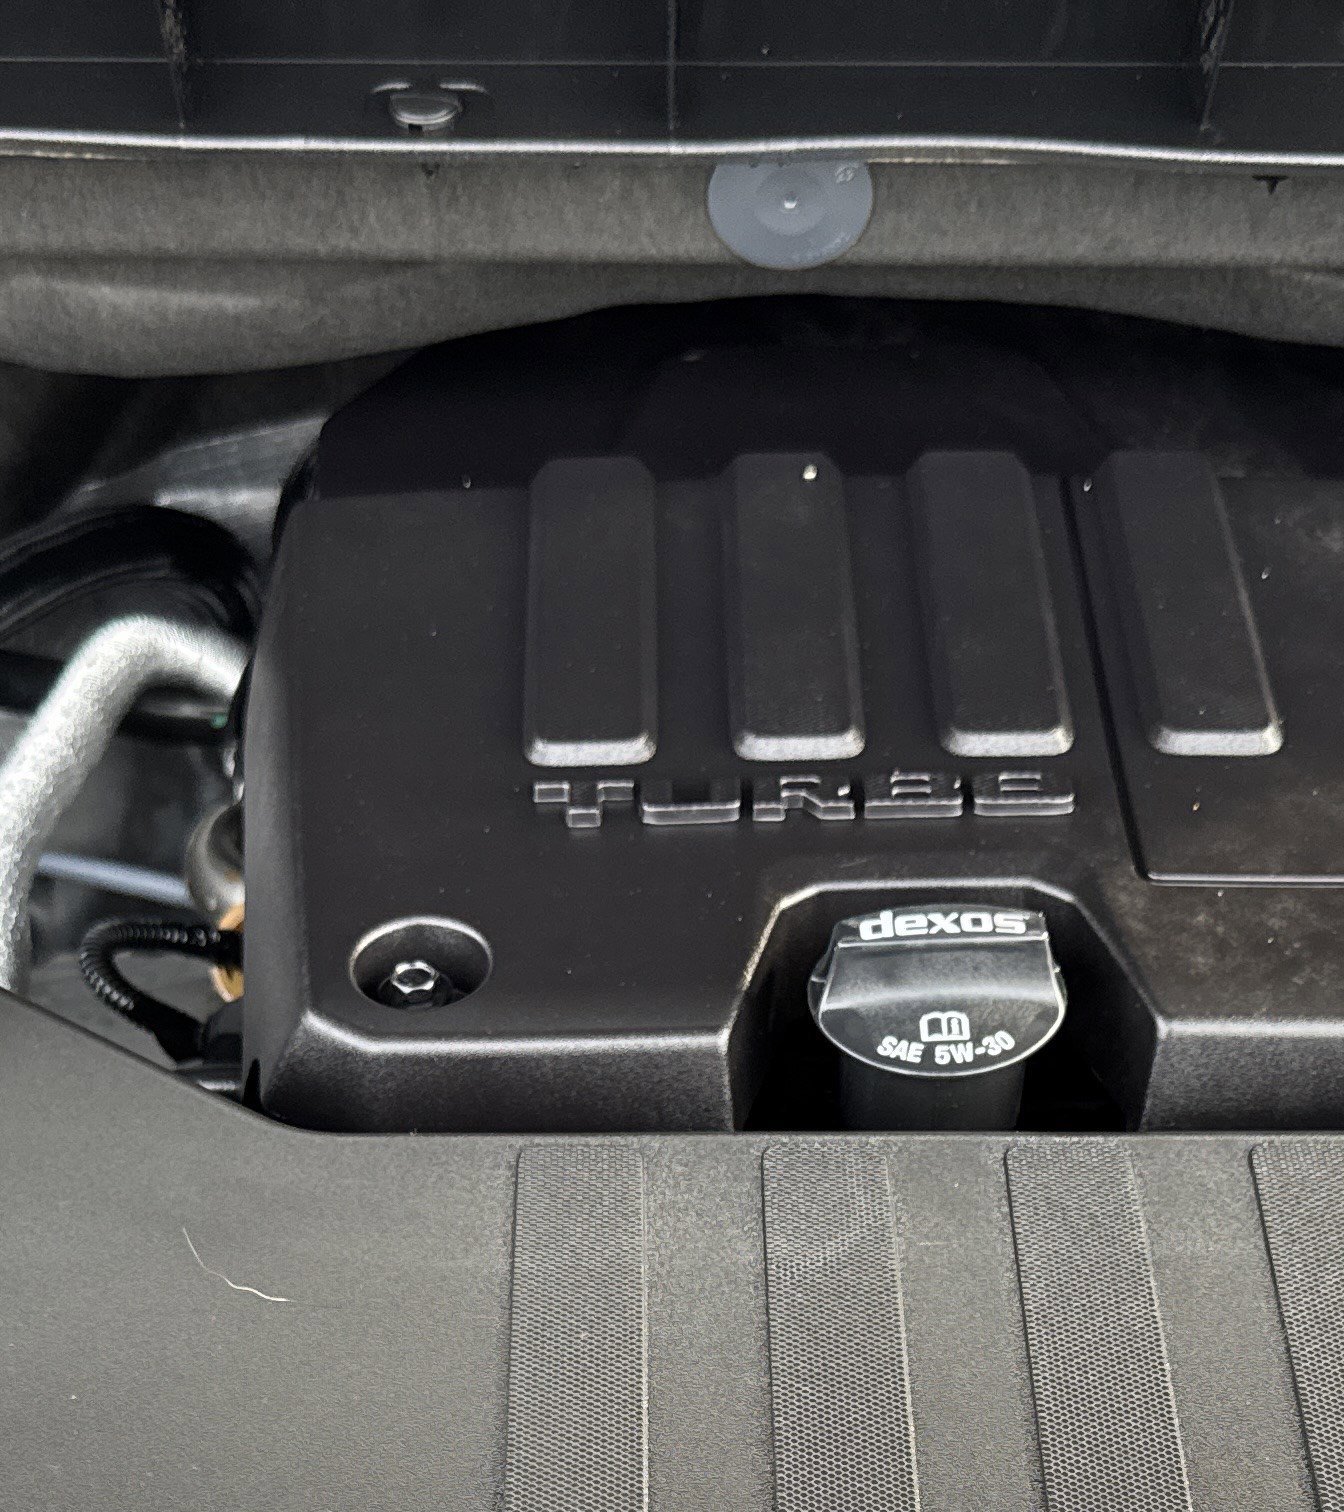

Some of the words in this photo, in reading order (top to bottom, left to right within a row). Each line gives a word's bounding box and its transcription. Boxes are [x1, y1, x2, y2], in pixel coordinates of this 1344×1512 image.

[533, 770, 1075, 829] TURBO
[858, 910, 1028, 941] dexos
[877, 1035, 925, 1064] SAE
[934, 1030, 1016, 1065] 5W-30
